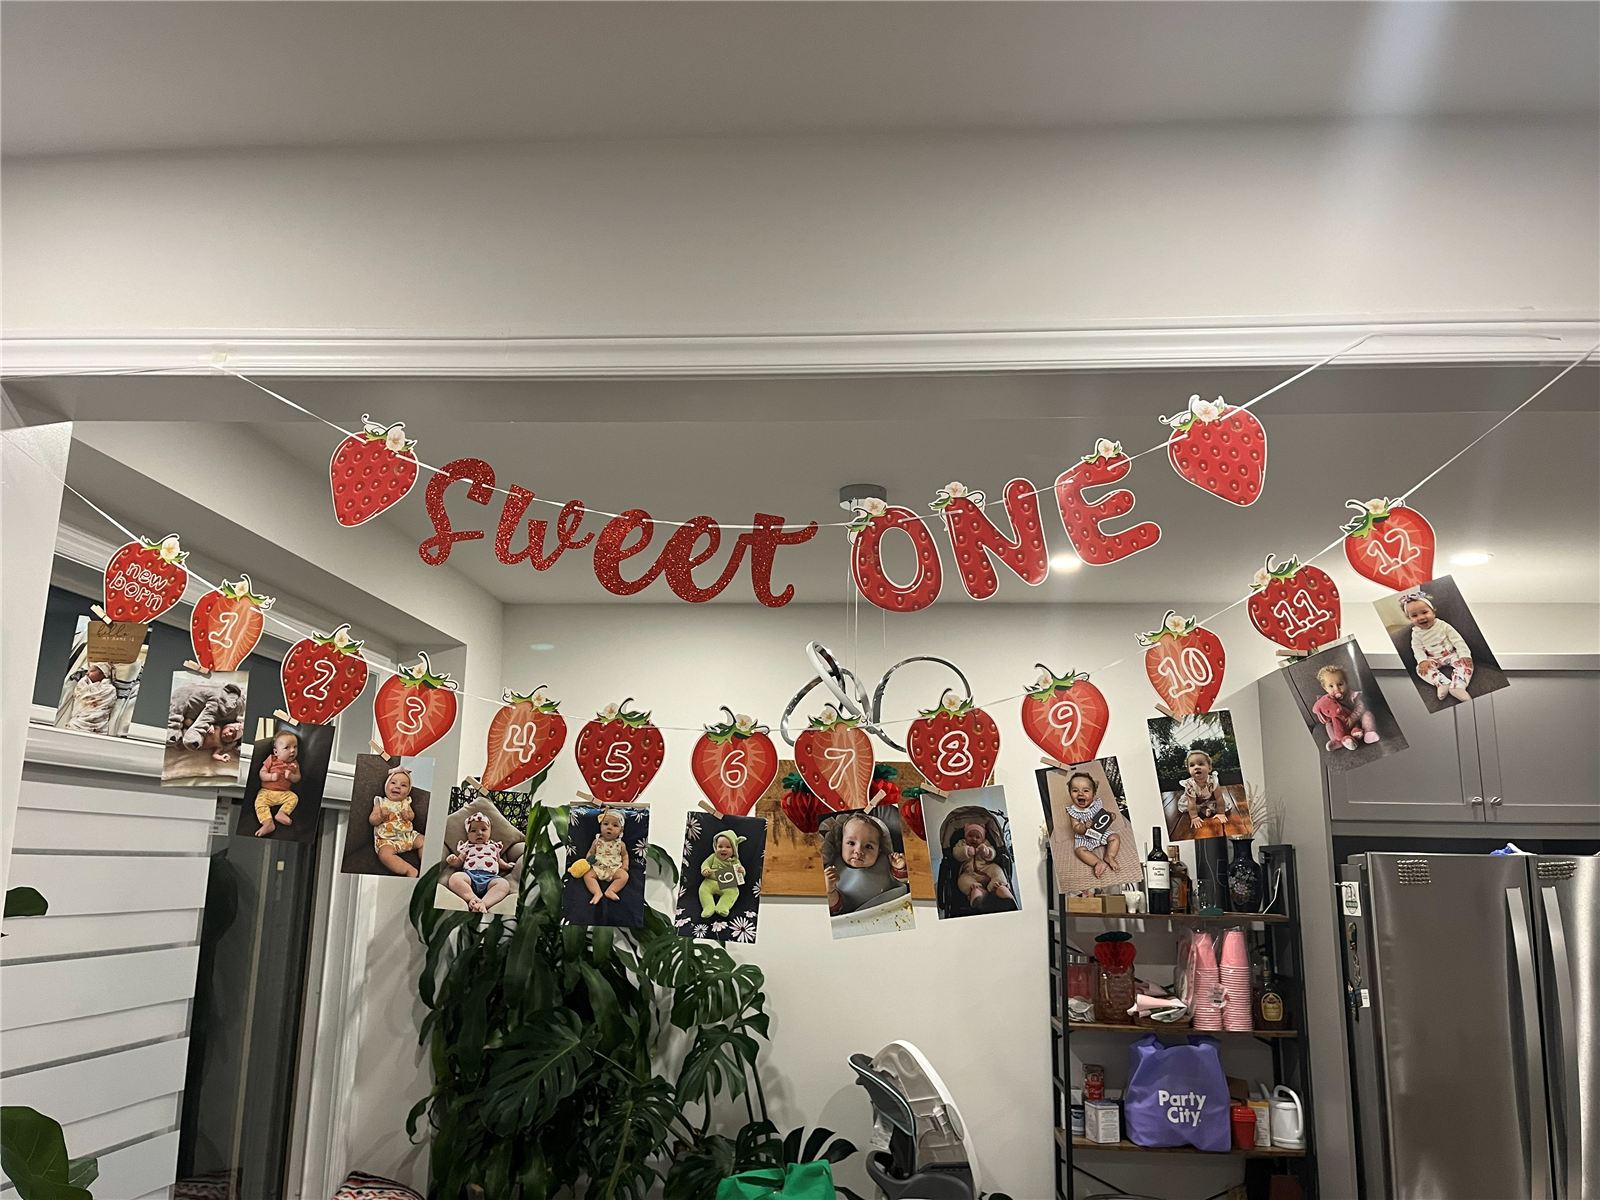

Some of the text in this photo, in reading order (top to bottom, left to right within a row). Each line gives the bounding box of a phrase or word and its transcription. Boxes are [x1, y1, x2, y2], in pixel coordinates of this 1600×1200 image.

[850, 450, 1162, 613] ONE
[1366, 527, 1421, 575] 12
[109, 570, 163, 612] born
[125, 562, 169, 592] new
[208, 611, 239, 648] 1
[1273, 589, 1330, 639] 11
[303, 659, 337, 700] 2
[1157, 647, 1213, 699] 10
[396, 696, 426, 735] 3
[1048, 700, 1082, 747] 9
[503, 721, 537, 763] 4
[601, 741, 633, 782] 5
[936, 730, 974, 776] 8
[720, 749, 748, 789] 6
[824, 747, 855, 790] 7
[1094, 814, 1110, 830] 9
[1158, 1089, 1206, 1110] Party
